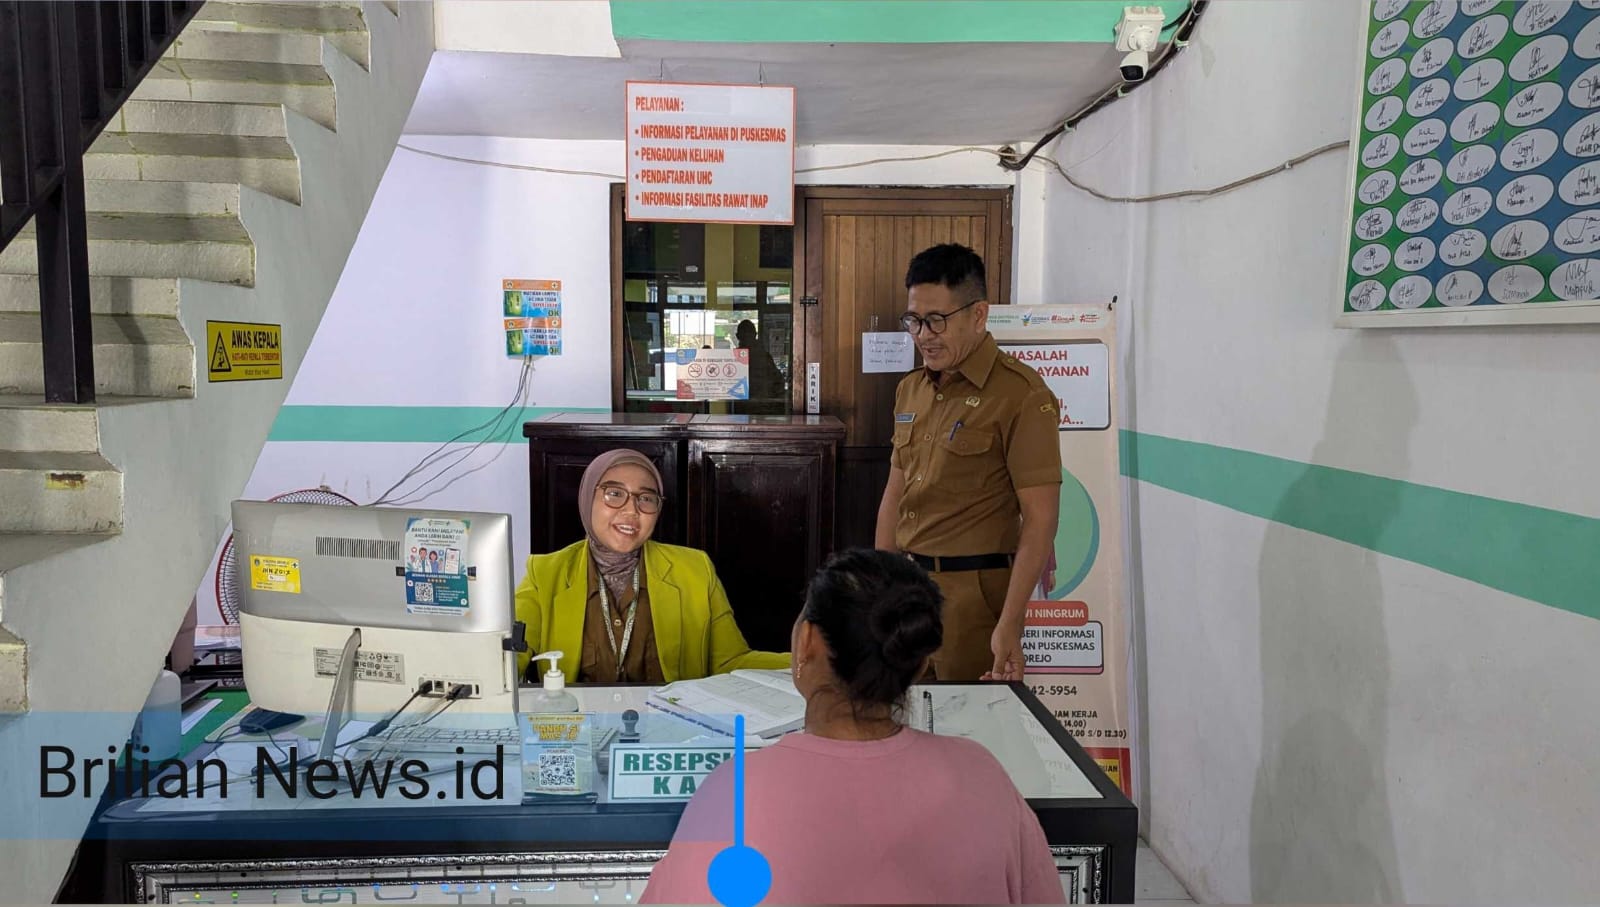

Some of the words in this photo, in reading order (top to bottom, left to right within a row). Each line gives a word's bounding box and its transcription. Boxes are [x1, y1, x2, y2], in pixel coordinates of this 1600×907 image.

[636, 96, 680, 112] PELAYANAN
[640, 124, 683, 140] INFORMASI
[685, 126, 728, 141] PELAYANAN
[730, 127, 738, 142] DI
[741, 128, 786, 142] PUSKESMAS
[641, 147, 688, 161] PENGADUAN
[689, 148, 724, 163] KELUHAN
[641, 169, 695, 184] PENDAFTARAN
[697, 171, 712, 184] UHC
[642, 192, 684, 207] INFORMASI
[685, 192, 722, 207] FASILITAS
[723, 194, 748, 208] RAWAT
[750, 194, 768, 208] INAP
[232, 330, 251, 348] AWAS
[254, 331, 279, 349] KEPALA
[1006, 350, 1067, 360] MASALAH
[1035, 609, 1084, 618] NINGRUM
[1042, 630, 1094, 638] INFORMASI
[1038, 642, 1095, 650] PUSKESMAS
